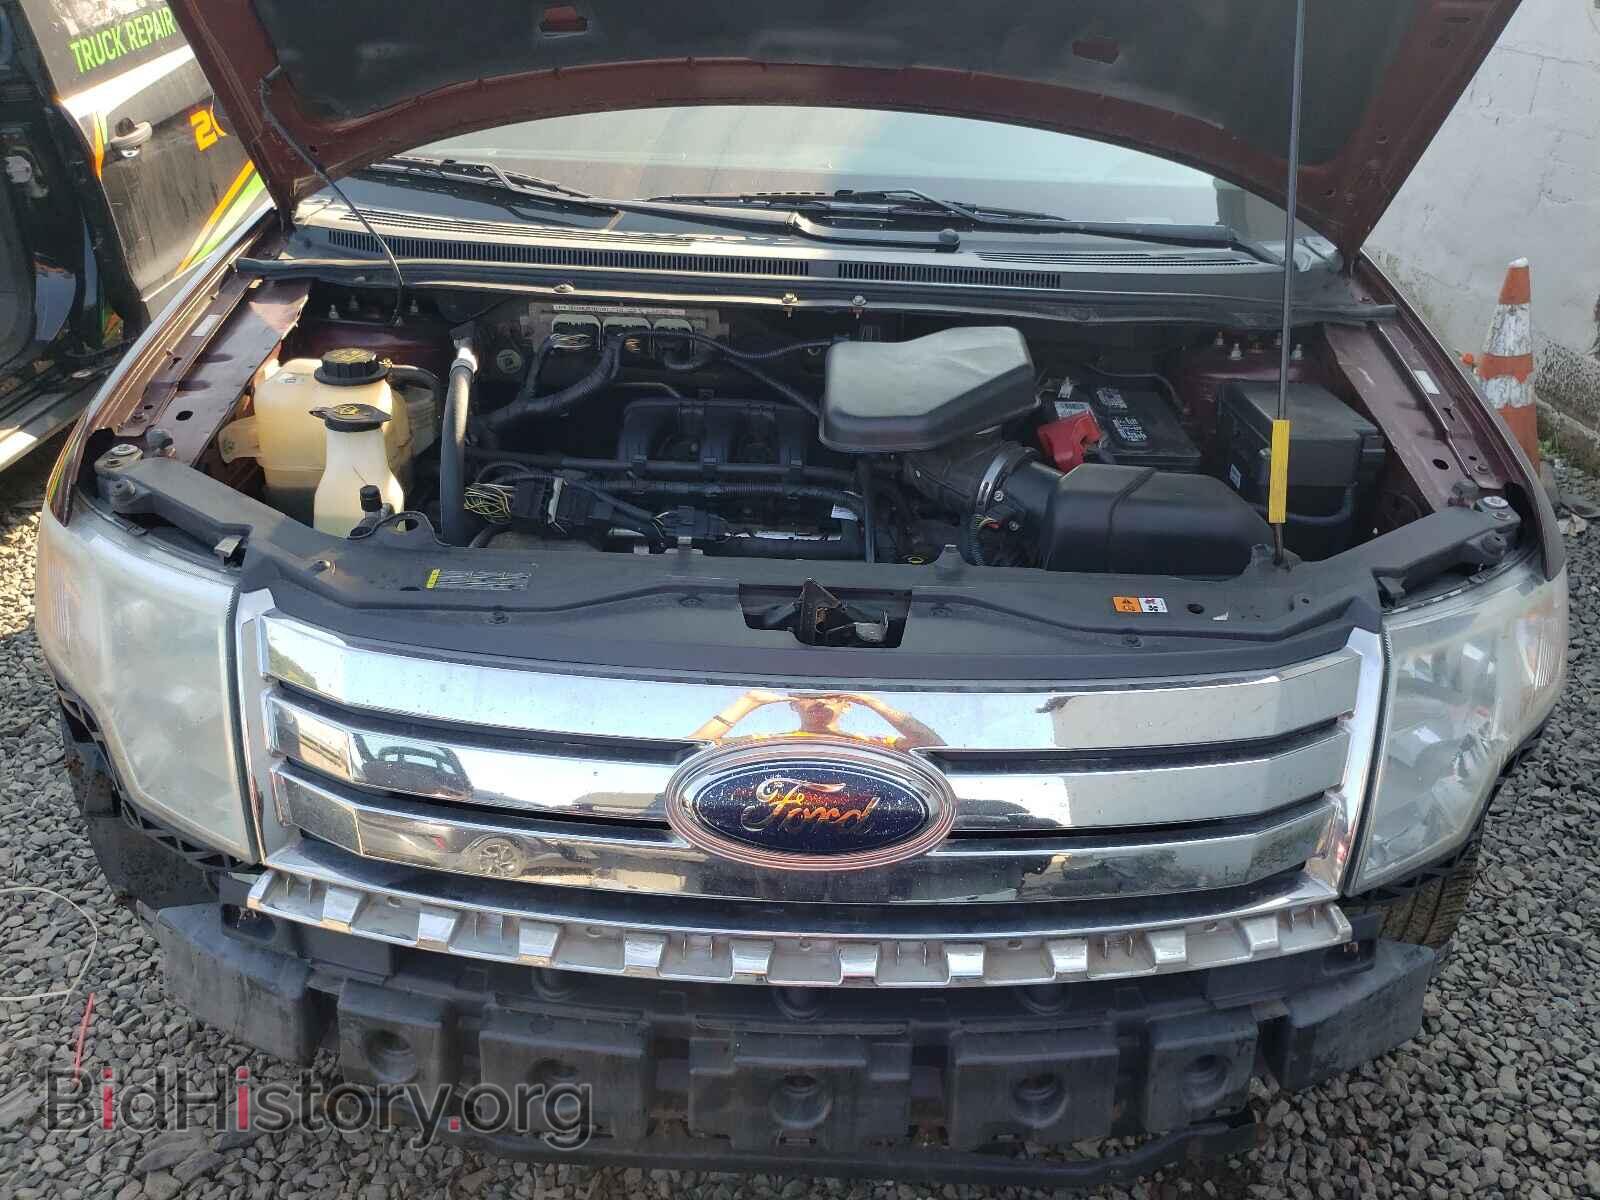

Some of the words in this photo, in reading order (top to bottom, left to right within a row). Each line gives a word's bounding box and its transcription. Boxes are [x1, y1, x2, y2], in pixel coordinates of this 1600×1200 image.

[70, 26, 127, 73] TRUCK
[124, 6, 177, 50] REPAIR
[740, 777, 881, 833] Ford
